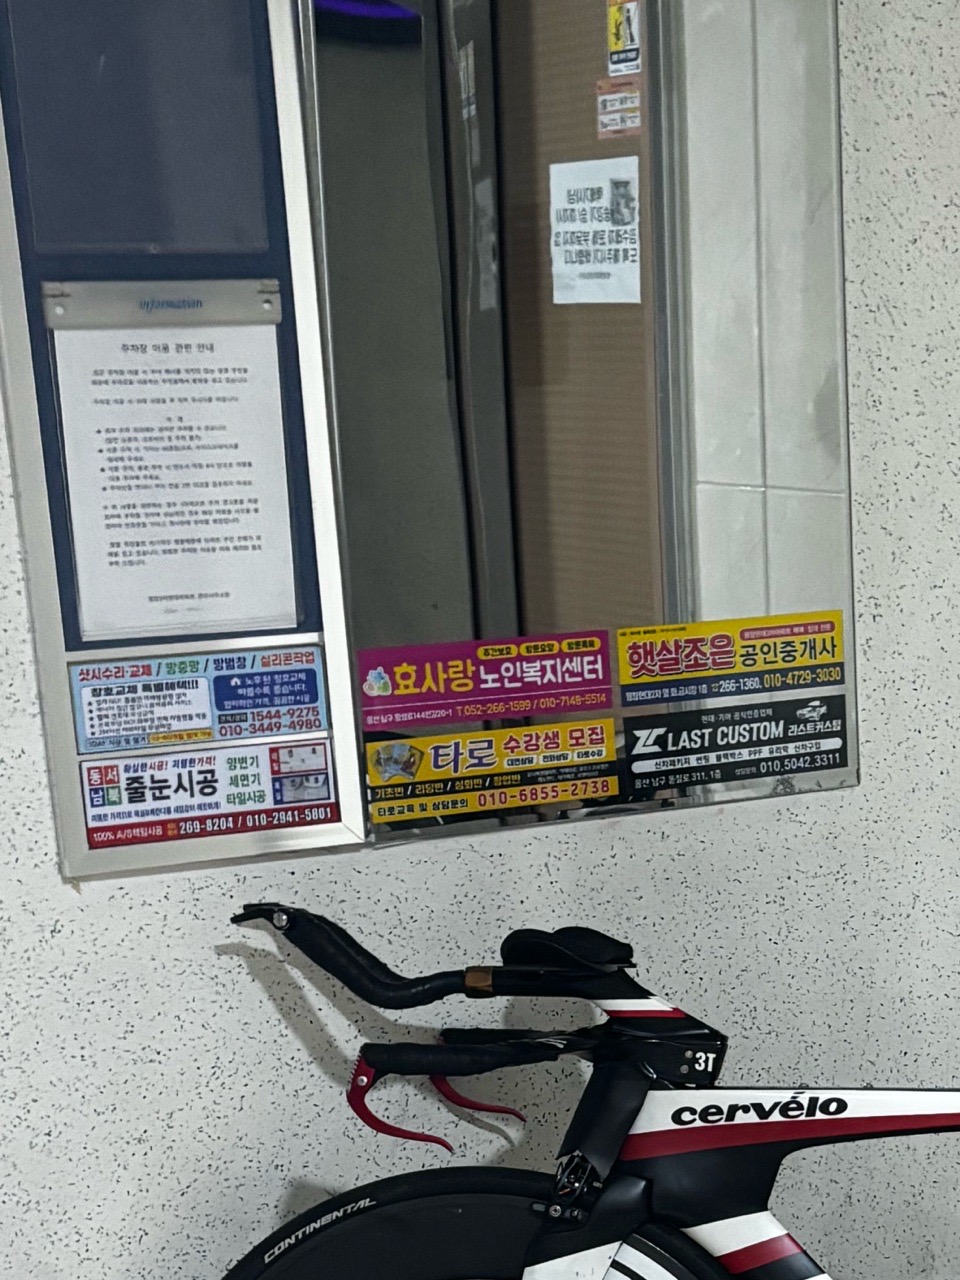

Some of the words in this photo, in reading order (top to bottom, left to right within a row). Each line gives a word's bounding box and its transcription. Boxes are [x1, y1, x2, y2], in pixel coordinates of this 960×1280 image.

[165, 660, 200, 675] 방충망
[213, 656, 247, 672] 방범창
[260, 652, 316, 667] 실리콘작업
[627, 633, 735, 678] 햇살조은
[739, 636, 838, 667] 공인중개사
[393, 659, 476, 696] 효사랑
[479, 654, 604, 689] 노인복지센터
[763, 667, 842, 688] 010-4729-3030
[250, 706, 319, 722] 1544-9275
[219, 718, 322, 737] 010-3449-4980
[667, 728, 713, 751] LAST
[716, 720, 785, 746] CUSTOM
[788, 719, 842, 737] 라스트커스텀
[226, 755, 260, 770] 양변기
[430, 739, 499, 775] 타로
[503, 731, 560, 754] 수강생
[568, 725, 606, 748] 모집
[748, 749, 763, 757] PPF
[760, 753, 841, 774] 010.5042.3311
[124, 768, 220, 804] 줄눈시공
[228, 772, 263, 788] 세면기
[226, 790, 266, 806] 타일시공
[478, 780, 611, 807] 010-6855-2738
[179, 817, 234, 835] 269-8204
[246, 807, 332, 827] 010-2941-5801
[694, 1052, 716, 1071] 3T
[671, 1091, 848, 1126] cervélo
[264, 1198, 376, 1264] CONTINENTAL
